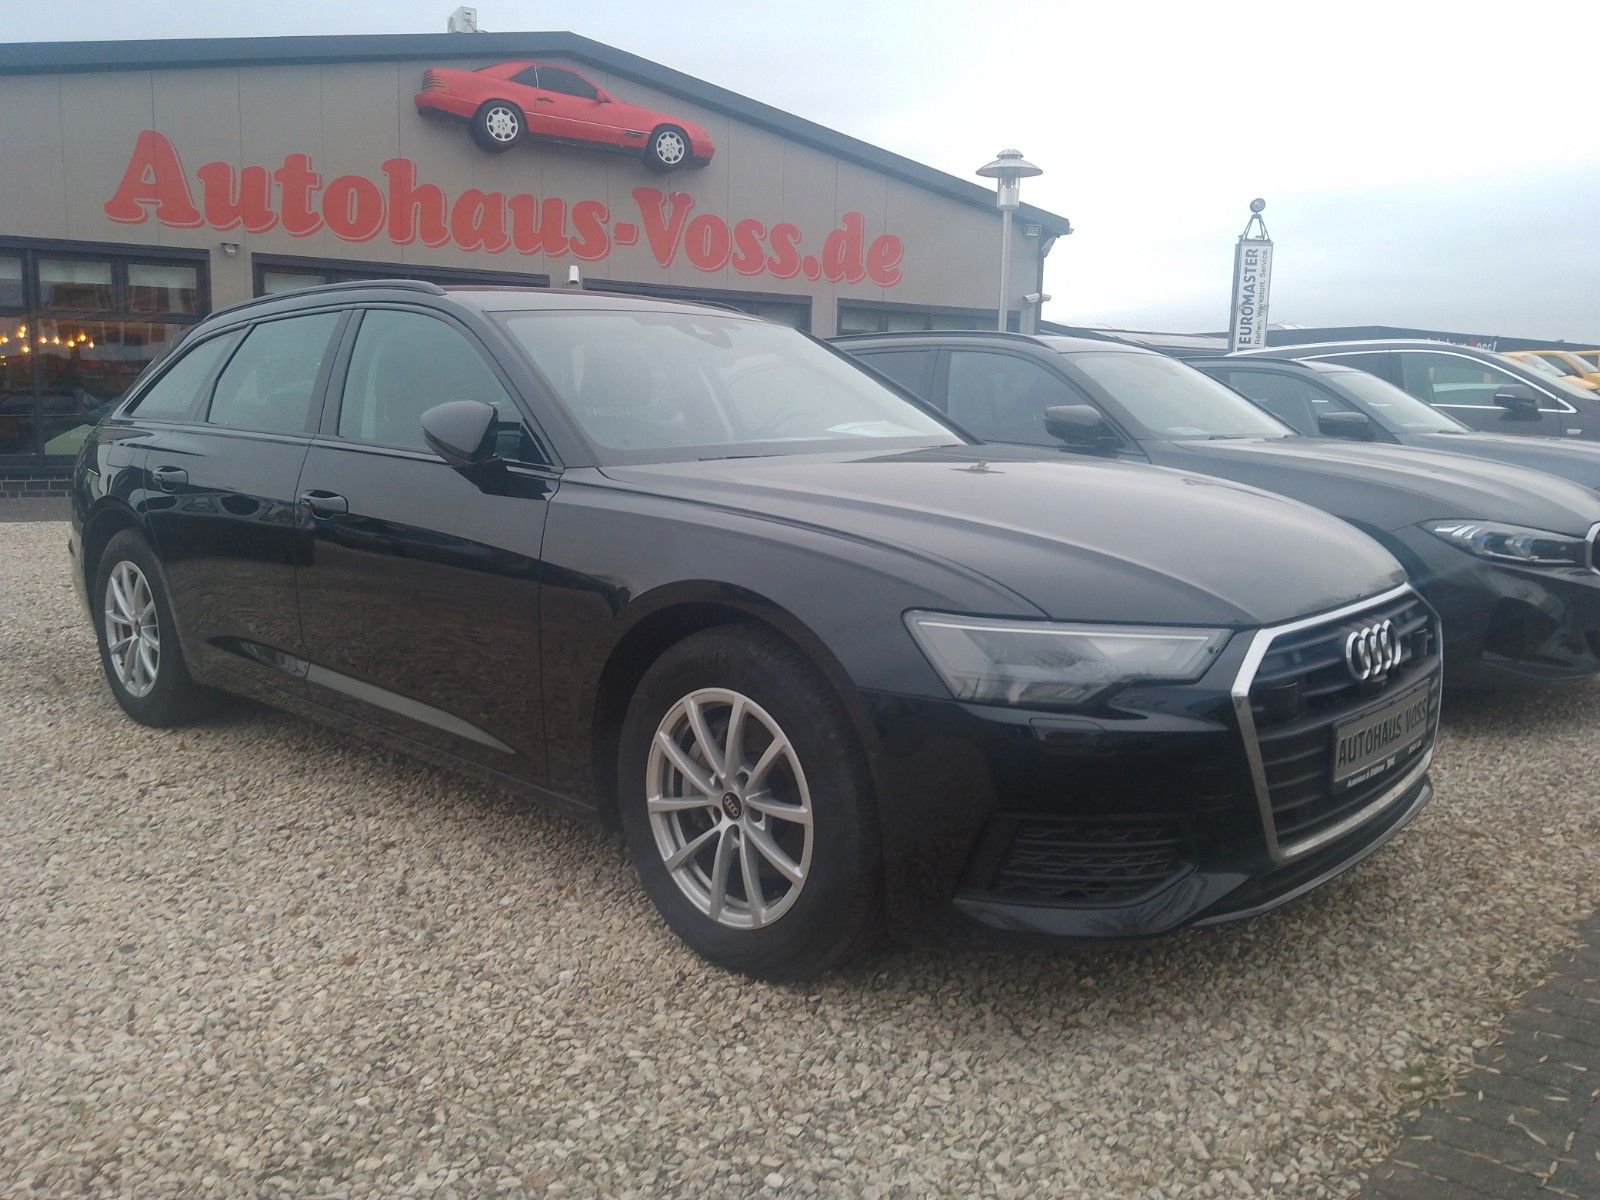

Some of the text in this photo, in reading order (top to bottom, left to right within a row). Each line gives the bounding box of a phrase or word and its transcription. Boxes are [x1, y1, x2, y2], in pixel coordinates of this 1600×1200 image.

[104, 129, 905, 288] Autohaus-Voss.de
[1238, 248, 1259, 345] EUROMASTER
[1337, 712, 1402, 769] AUTOHAUS
